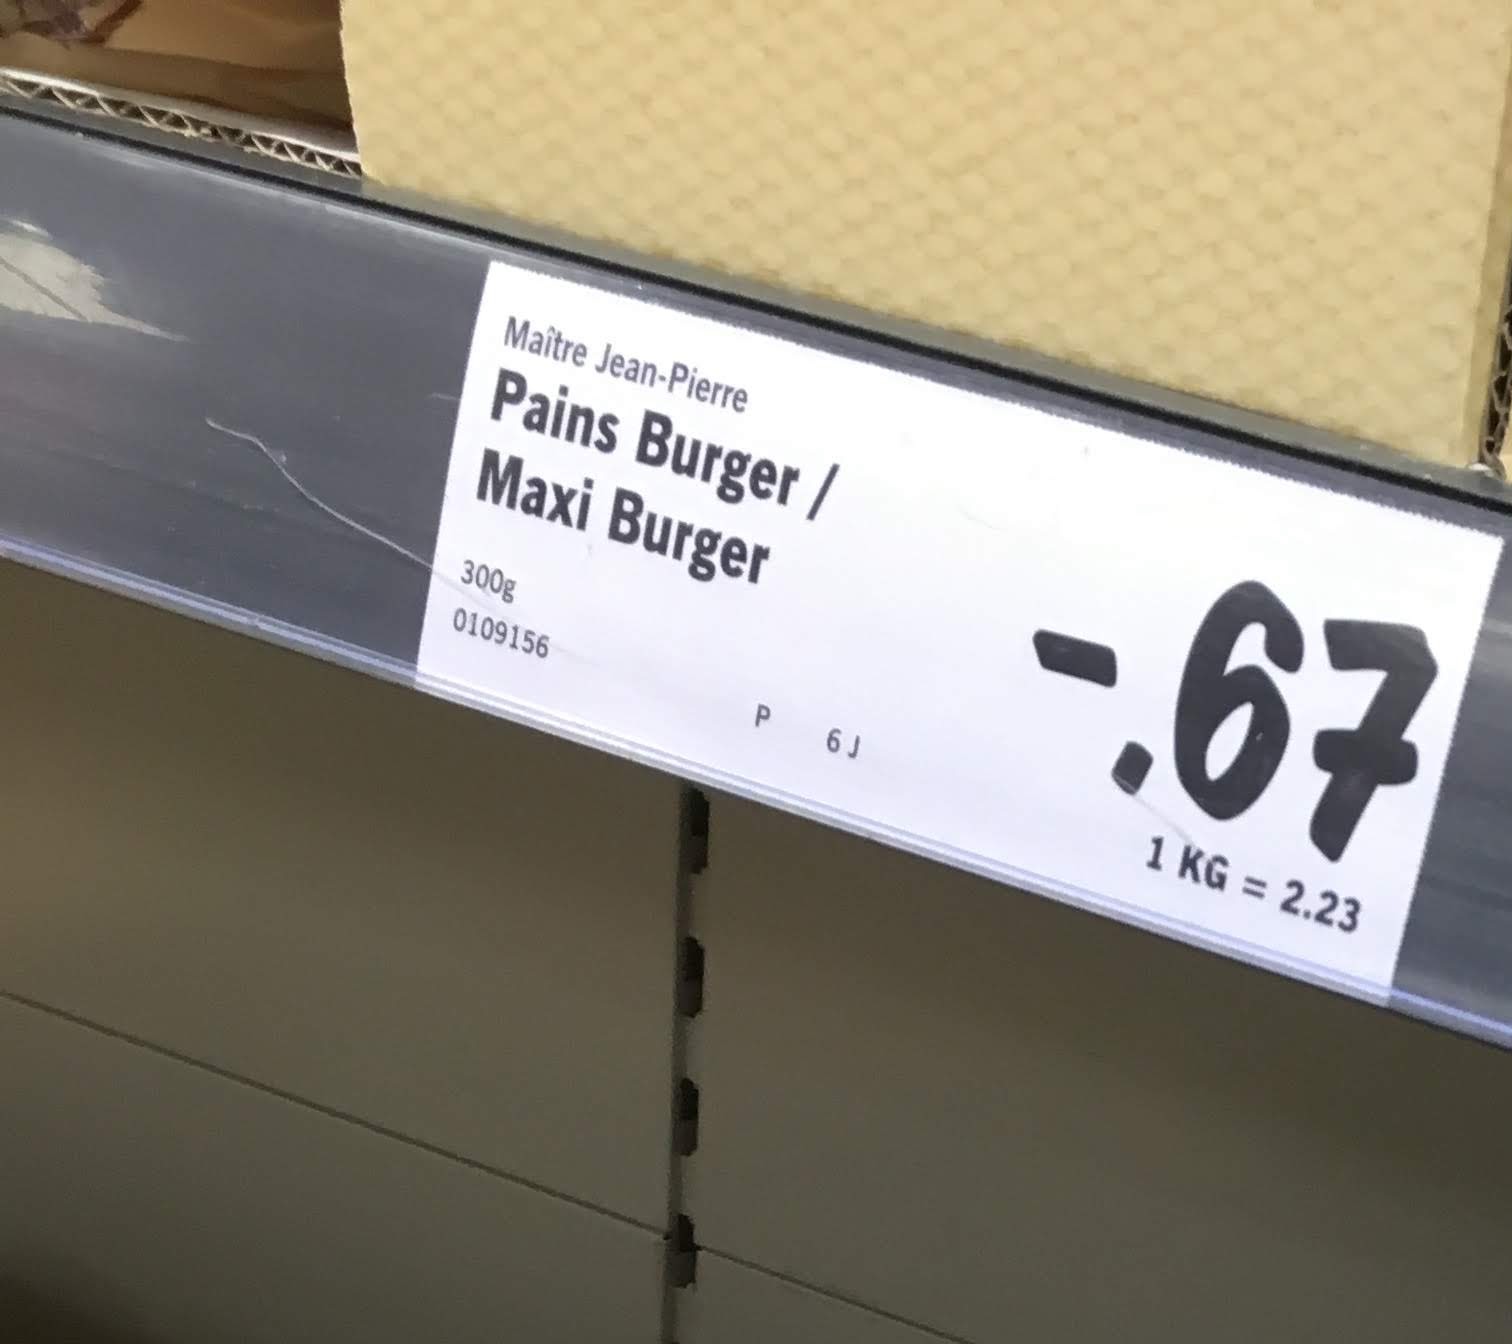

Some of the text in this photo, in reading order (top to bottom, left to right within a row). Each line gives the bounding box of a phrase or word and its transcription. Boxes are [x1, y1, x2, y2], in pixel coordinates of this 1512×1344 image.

[503, 315, 749, 413] Maître Jean-Pierre
[490, 368, 840, 521] Pains Burger /
[476, 448, 771, 585] Maxi Burger
[460, 559, 517, 604] 300g
[452, 608, 551, 659] 0109156
[754, 703, 771, 728] P
[1146, 837, 1361, 934] 1 KG = 2.23
